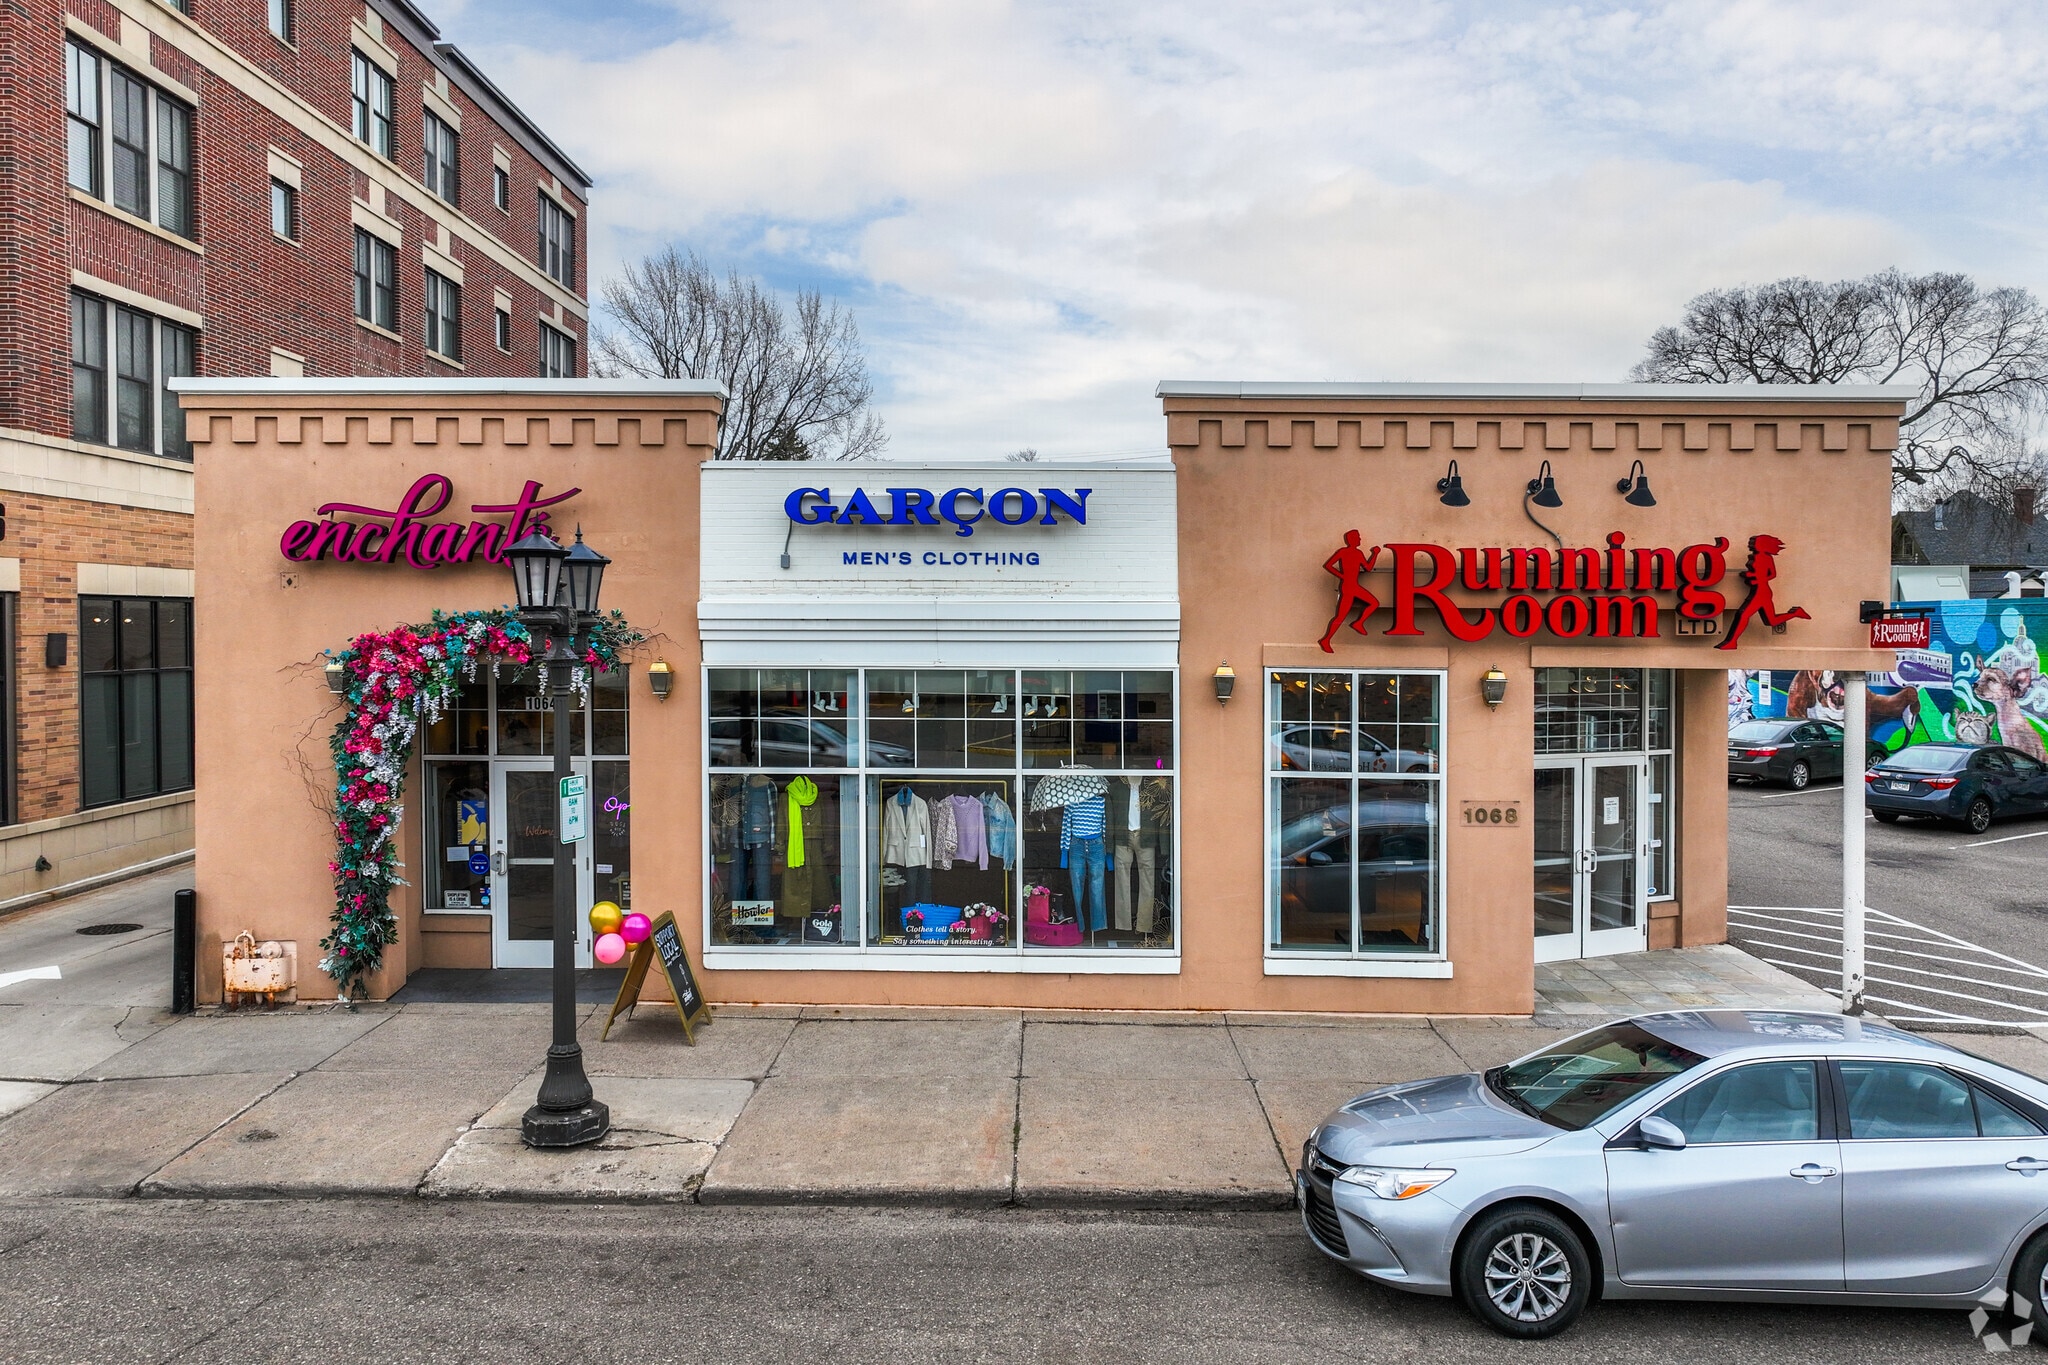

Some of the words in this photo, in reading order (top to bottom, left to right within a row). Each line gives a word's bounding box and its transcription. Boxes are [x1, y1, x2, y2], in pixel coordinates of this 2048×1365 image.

[784, 487, 1092, 537] GARÇON
[843, 551, 912, 566] MEN'S
[923, 551, 1040, 566] CLOTHING
[1383, 530, 1730, 642] Running
[1677, 618, 1723, 636] LTD.
[1880, 621, 1919, 643] Running
[603, 796, 631, 820] Op
[1463, 807, 1519, 824] 1068
[737, 904, 770, 920] Howler
[655, 924, 676, 947] SUPPORT
[906, 925, 933, 933] Clothes
[935, 925, 947, 933] tell
[956, 926, 977, 934] story.
[661, 939, 680, 960] LOCAL
[893, 937, 908, 946] Say
[909, 938, 949, 946] something
[951, 938, 995, 946] interesting.
